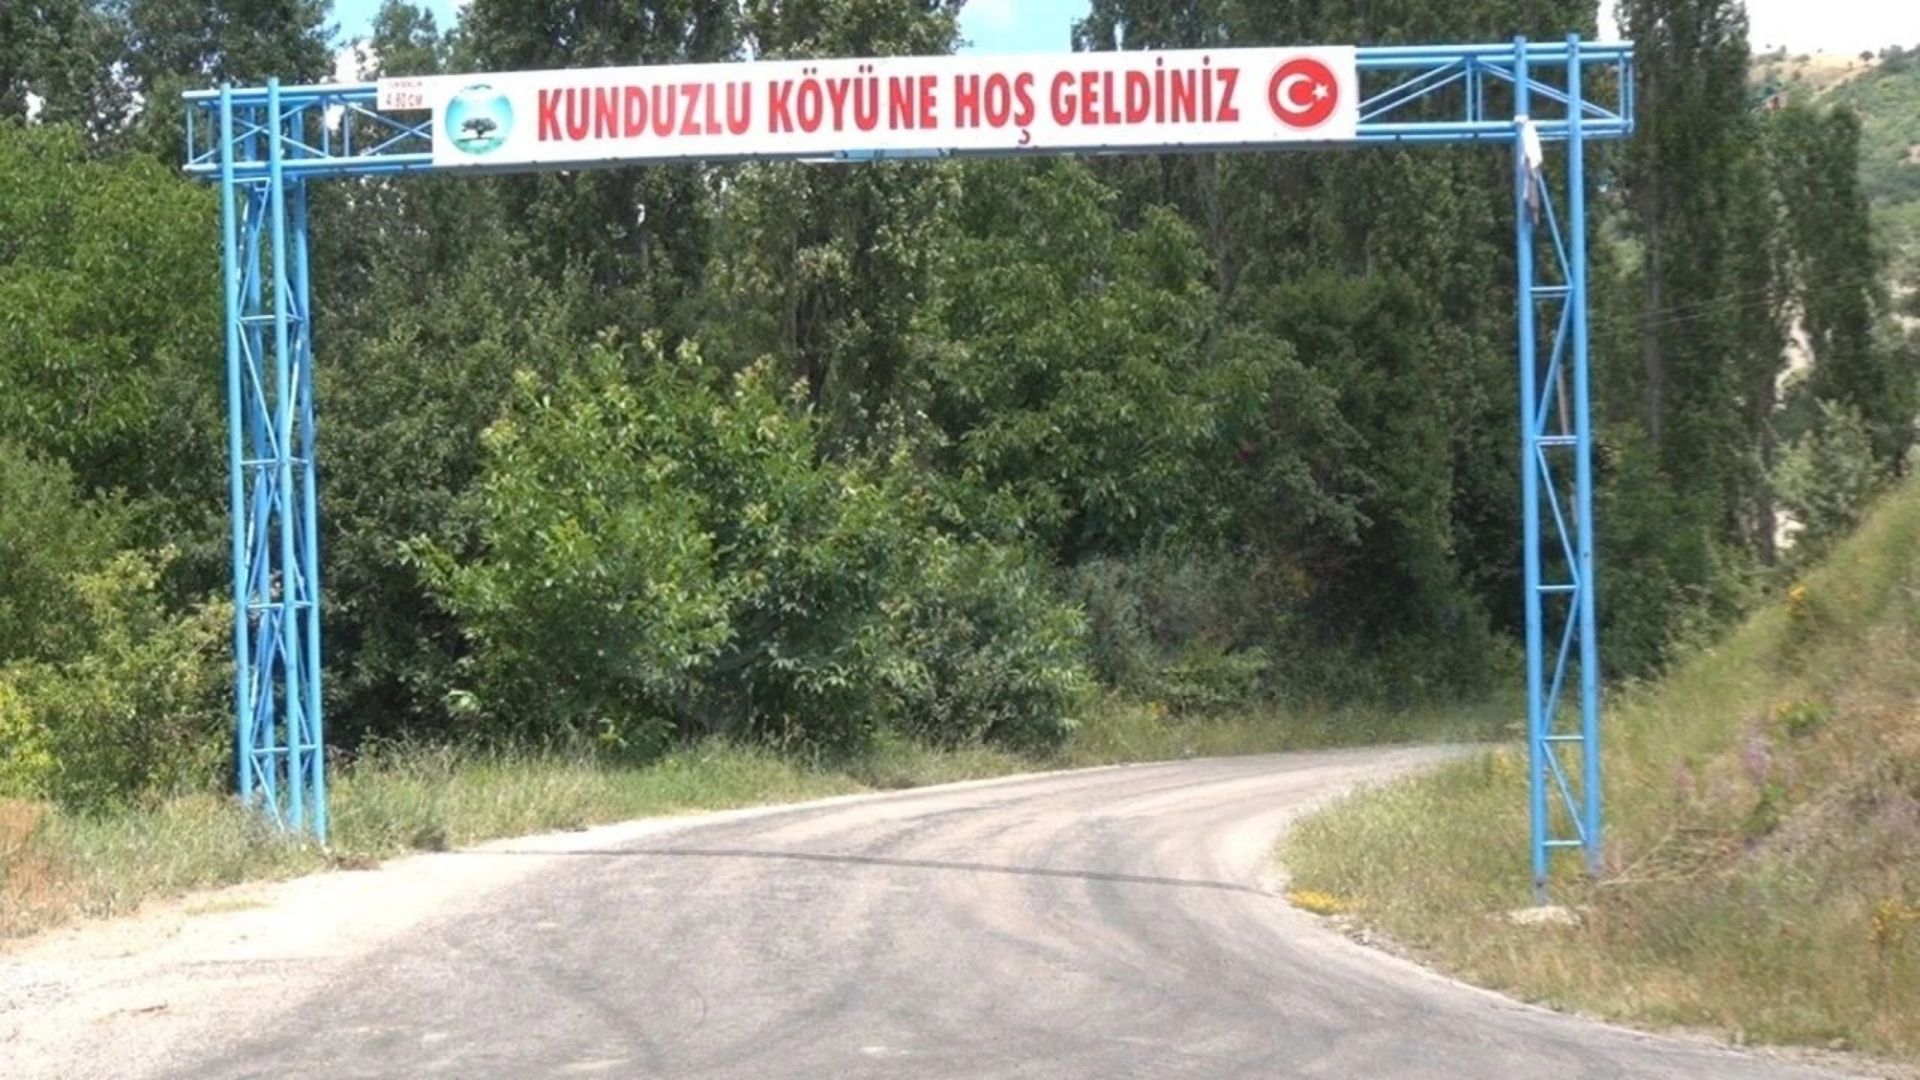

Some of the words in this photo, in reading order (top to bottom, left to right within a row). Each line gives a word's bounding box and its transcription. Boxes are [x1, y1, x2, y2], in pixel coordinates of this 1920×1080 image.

[538, 82, 751, 141] KUNDUZLU
[955, 72, 1035, 145] HOŞ
[1050, 56, 1240, 126] GELDİNİZ
